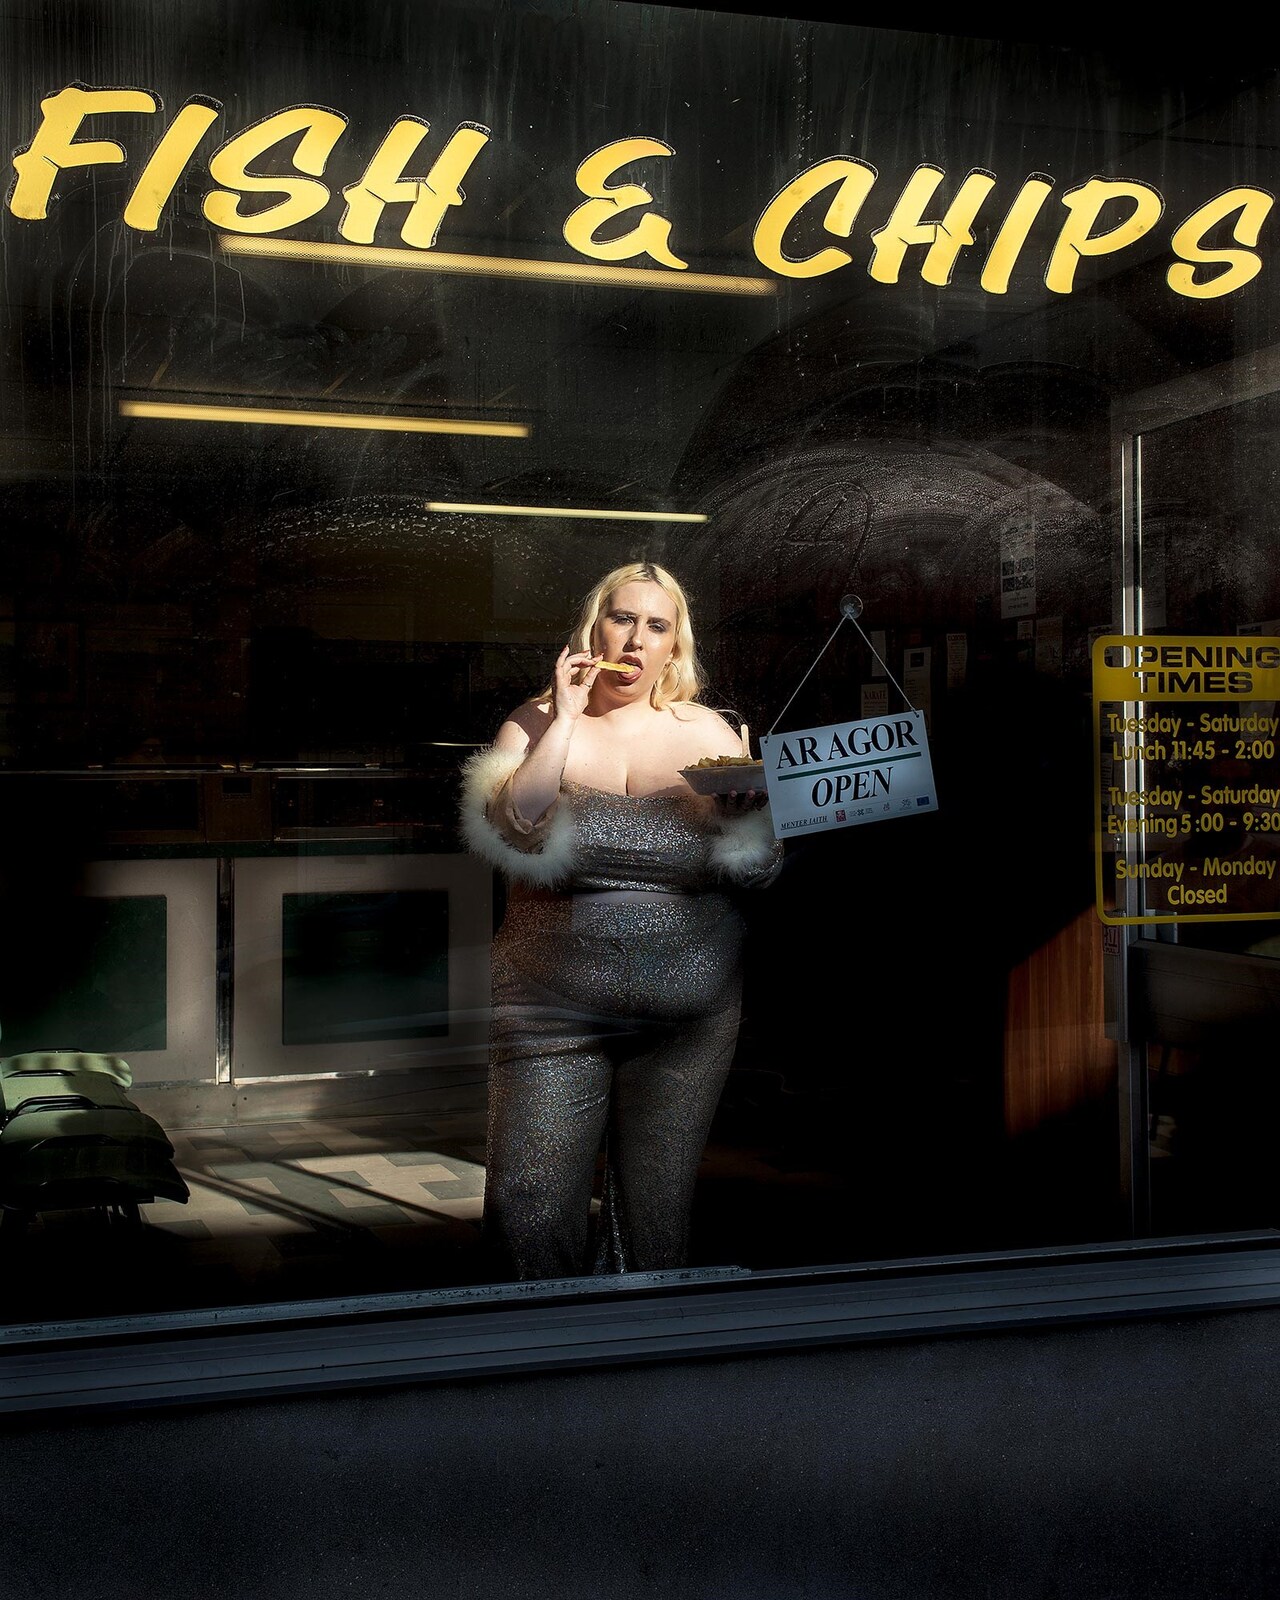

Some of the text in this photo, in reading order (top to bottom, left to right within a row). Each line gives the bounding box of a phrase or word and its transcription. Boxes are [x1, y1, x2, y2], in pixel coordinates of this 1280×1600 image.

[8, 81, 1275, 299] FISH & CHIPS
[1104, 645, 1280, 668] OPENING
[1133, 671, 1253, 693] TIMES
[1106, 712, 1182, 738] Tuesday
[1200, 712, 1280, 737] Saturday
[776, 720, 919, 769] AR AGOR
[1113, 739, 1167, 761] Lunch
[1171, 740, 1216, 760] 11:45
[1235, 739, 1275, 760] 2:00
[811, 767, 893, 807] OPEN
[1108, 785, 1183, 811] Tuesday
[1201, 783, 1280, 809] Saturday
[1107, 812, 1177, 838] Evening
[1242, 811, 1280, 833] 9:30
[1115, 857, 1184, 883] Sunday
[1203, 855, 1276, 879] Monday
[1167, 883, 1228, 905] Closed
